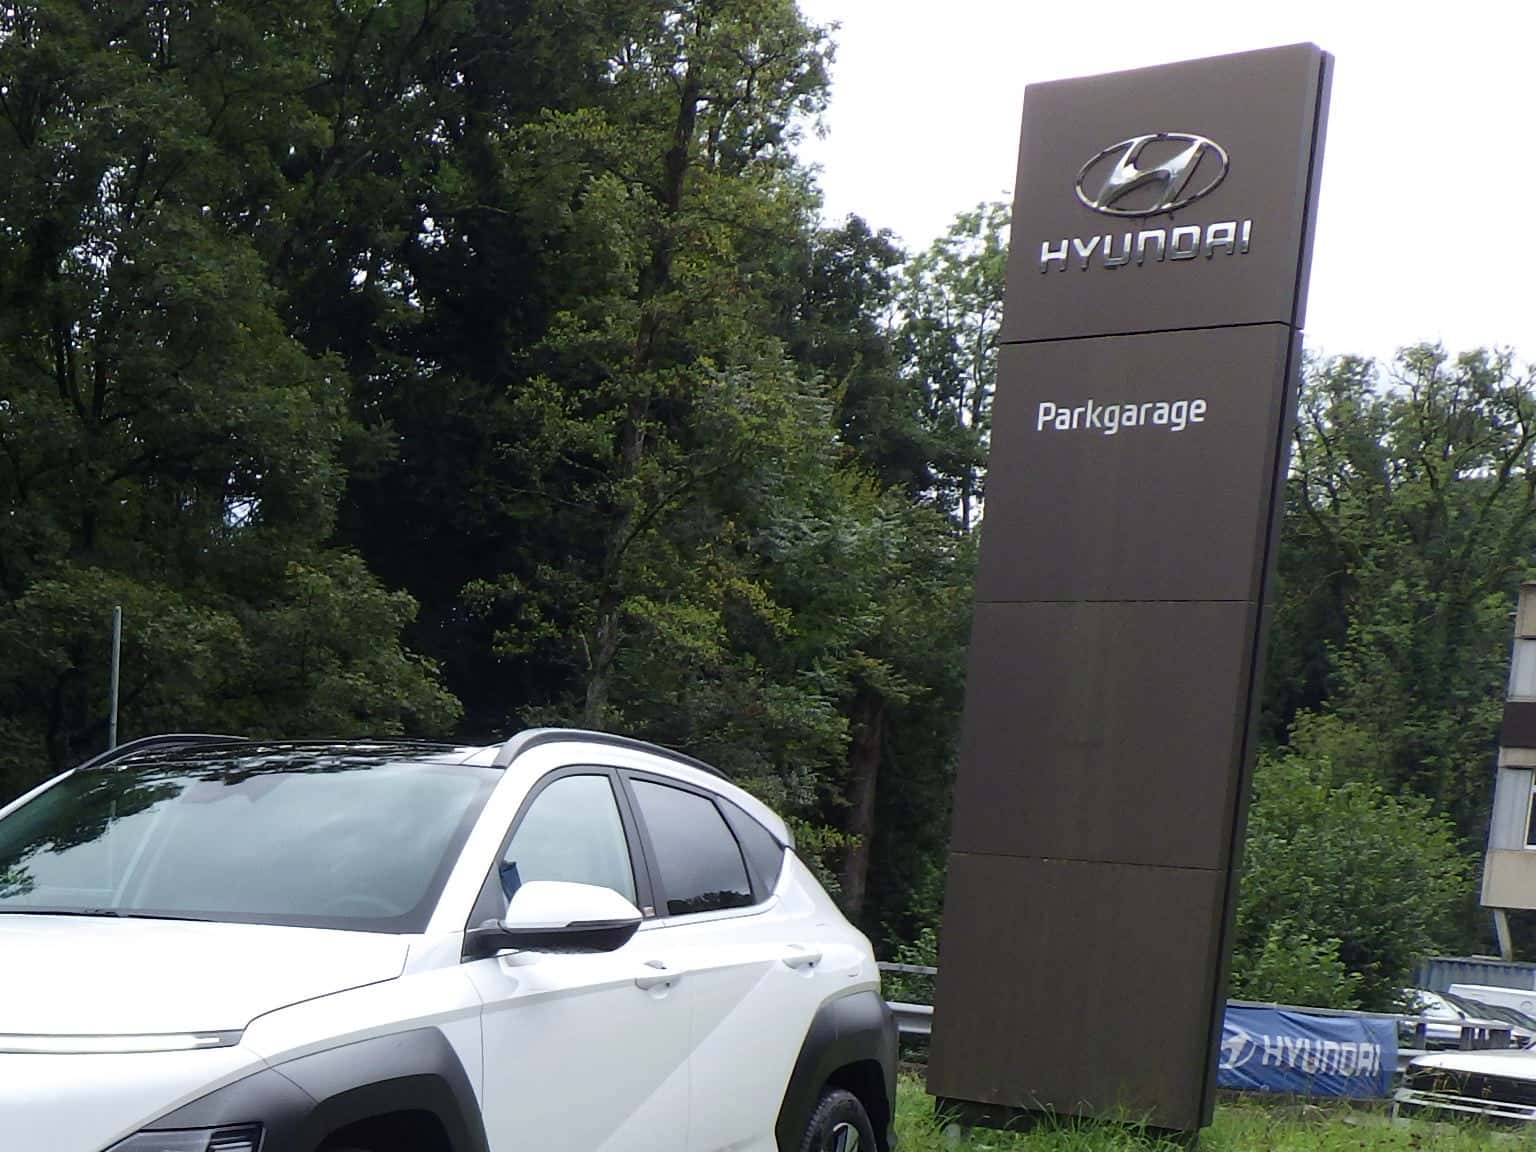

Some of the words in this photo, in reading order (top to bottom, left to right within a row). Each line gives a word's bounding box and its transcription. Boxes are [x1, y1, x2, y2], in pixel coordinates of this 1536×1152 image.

[1039, 219, 1253, 274] HYUNDAI
[1036, 399, 1208, 435] Parkgarage
[1261, 1034, 1381, 1078] HYUNDAI
